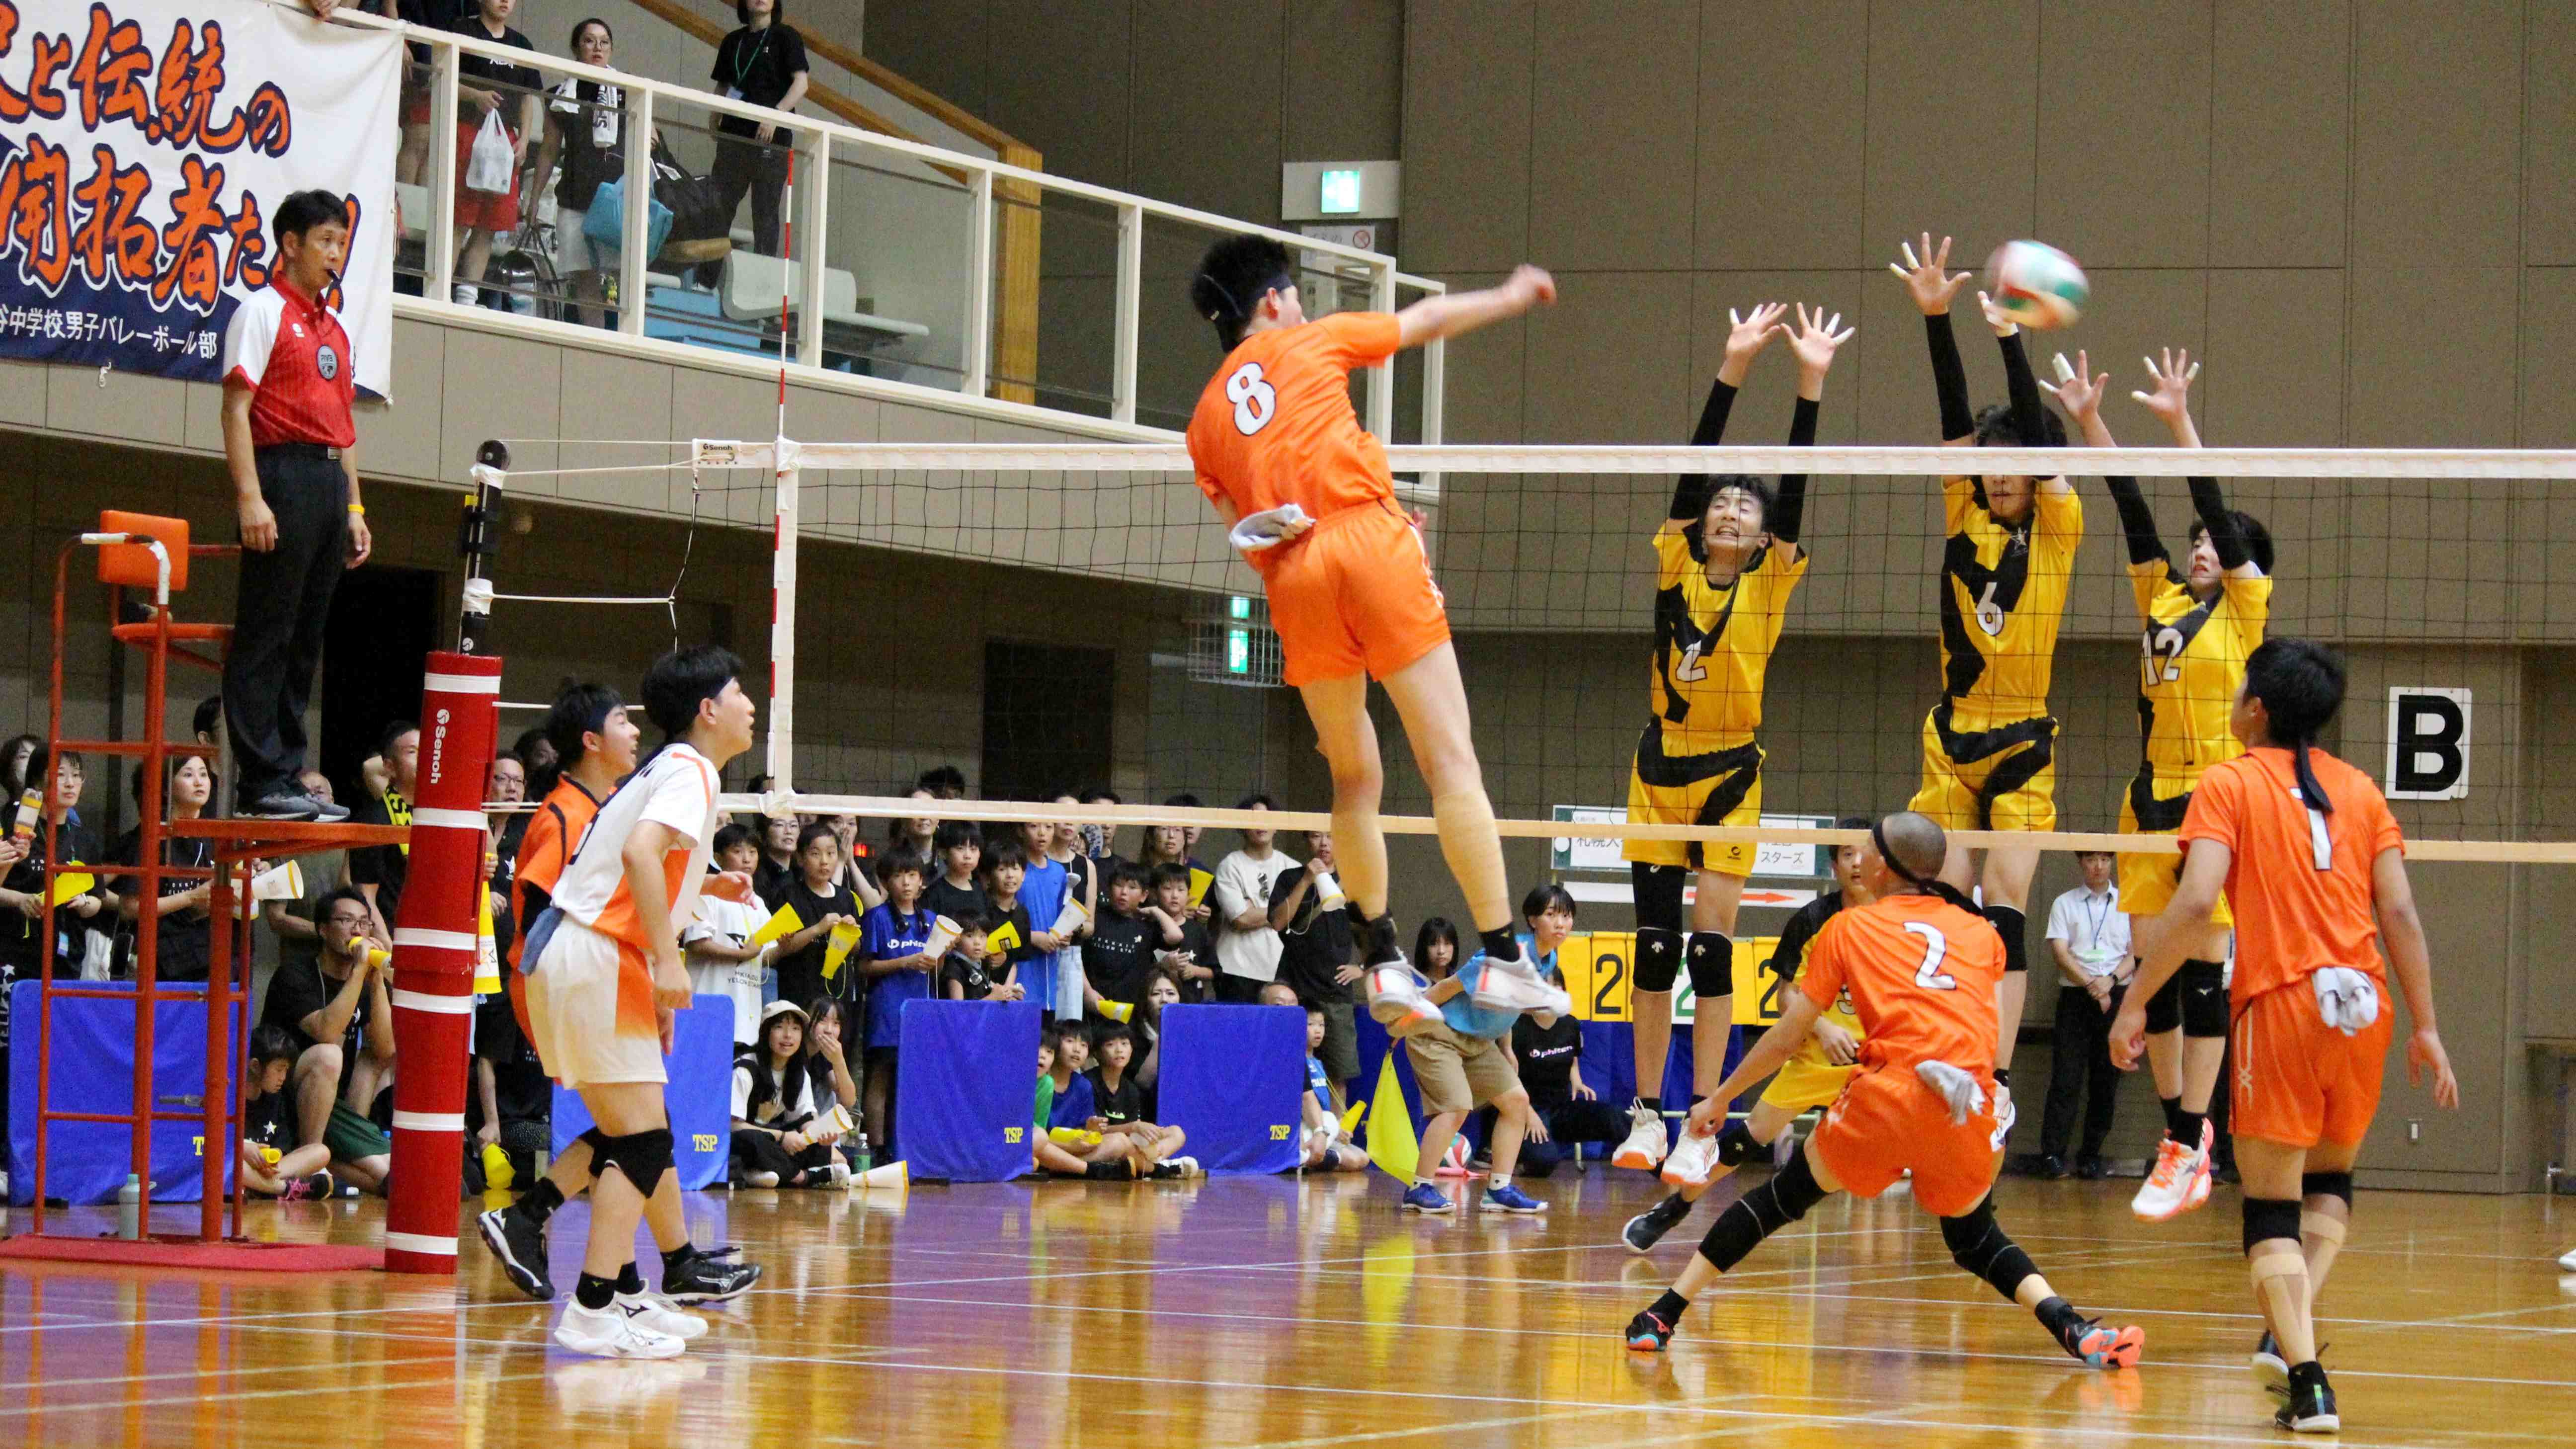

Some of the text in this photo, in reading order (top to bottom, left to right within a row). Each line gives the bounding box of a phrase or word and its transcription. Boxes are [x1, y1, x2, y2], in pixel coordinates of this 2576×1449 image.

[1226, 362, 1276, 436] 8
[1976, 582, 2004, 636] 6
[2142, 627, 2183, 686] 12
[431, 725, 446, 784] Senoh
[2395, 695, 2463, 792] B
[1761, 851, 1805, 864] スターズ
[2289, 788, 2332, 870] 1
[1595, 954, 1624, 1014] 2
[1903, 922, 1957, 990] 2
[1541, 1046, 1574, 1058] phiten
[692, 1134, 718, 1152] TSP
[1004, 1127, 1024, 1143] TSP
[1270, 1125, 1290, 1140] TSP
